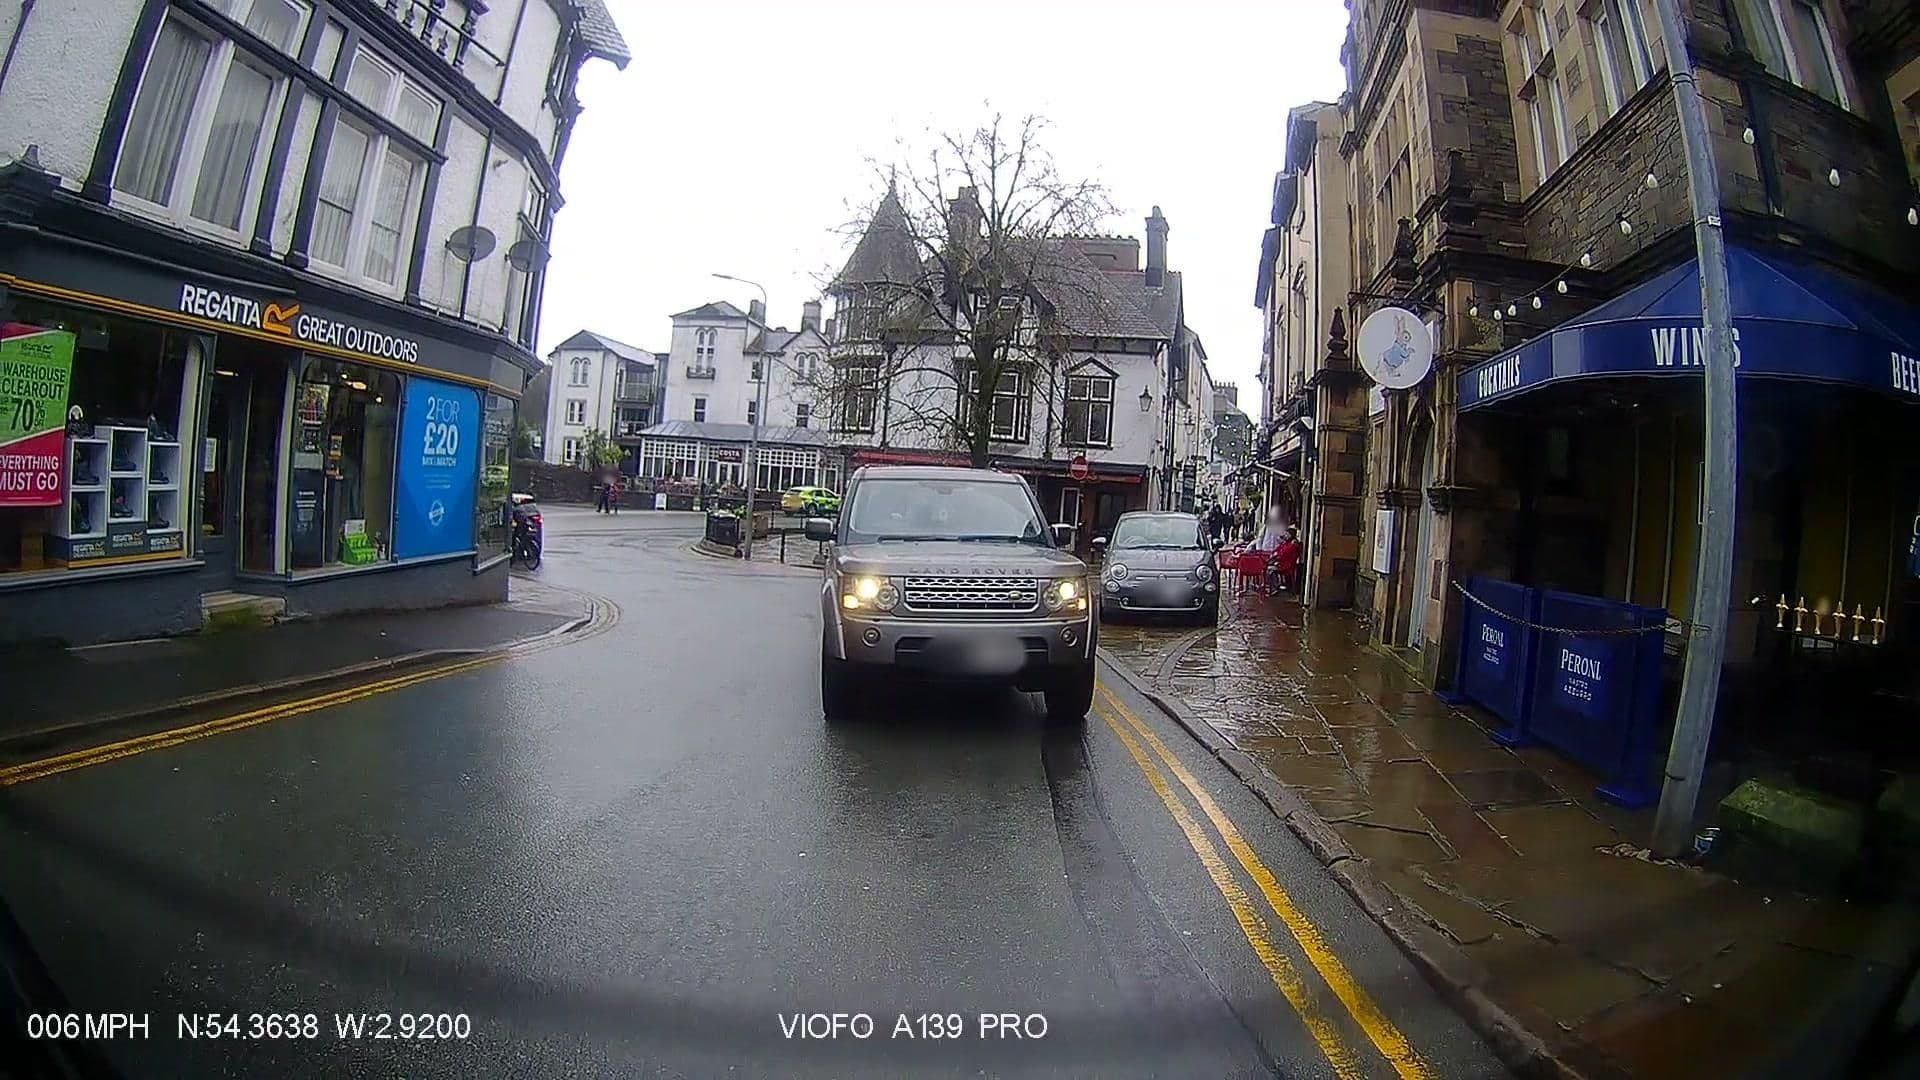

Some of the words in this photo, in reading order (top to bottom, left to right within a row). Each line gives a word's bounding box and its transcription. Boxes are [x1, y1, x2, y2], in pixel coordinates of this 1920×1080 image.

[180, 283, 260, 328] REGATTA
[298, 315, 344, 350] GREAT
[345, 326, 418, 363] OUTDOORS
[1651, 327, 1741, 368] WINS
[3, 361, 66, 382] WAREHOUSE
[1479, 354, 1521, 398] COCKTAILS
[2, 378, 64, 400] CLEAROUT
[426, 396, 435, 420] 2
[436, 398, 460, 422] FOR
[424, 422, 458, 455] £20
[719, 449, 740, 457] COSTA
[36, 472, 58, 491] GO
[908, 567, 960, 575] LAND
[970, 568, 1034, 576] ROVER
